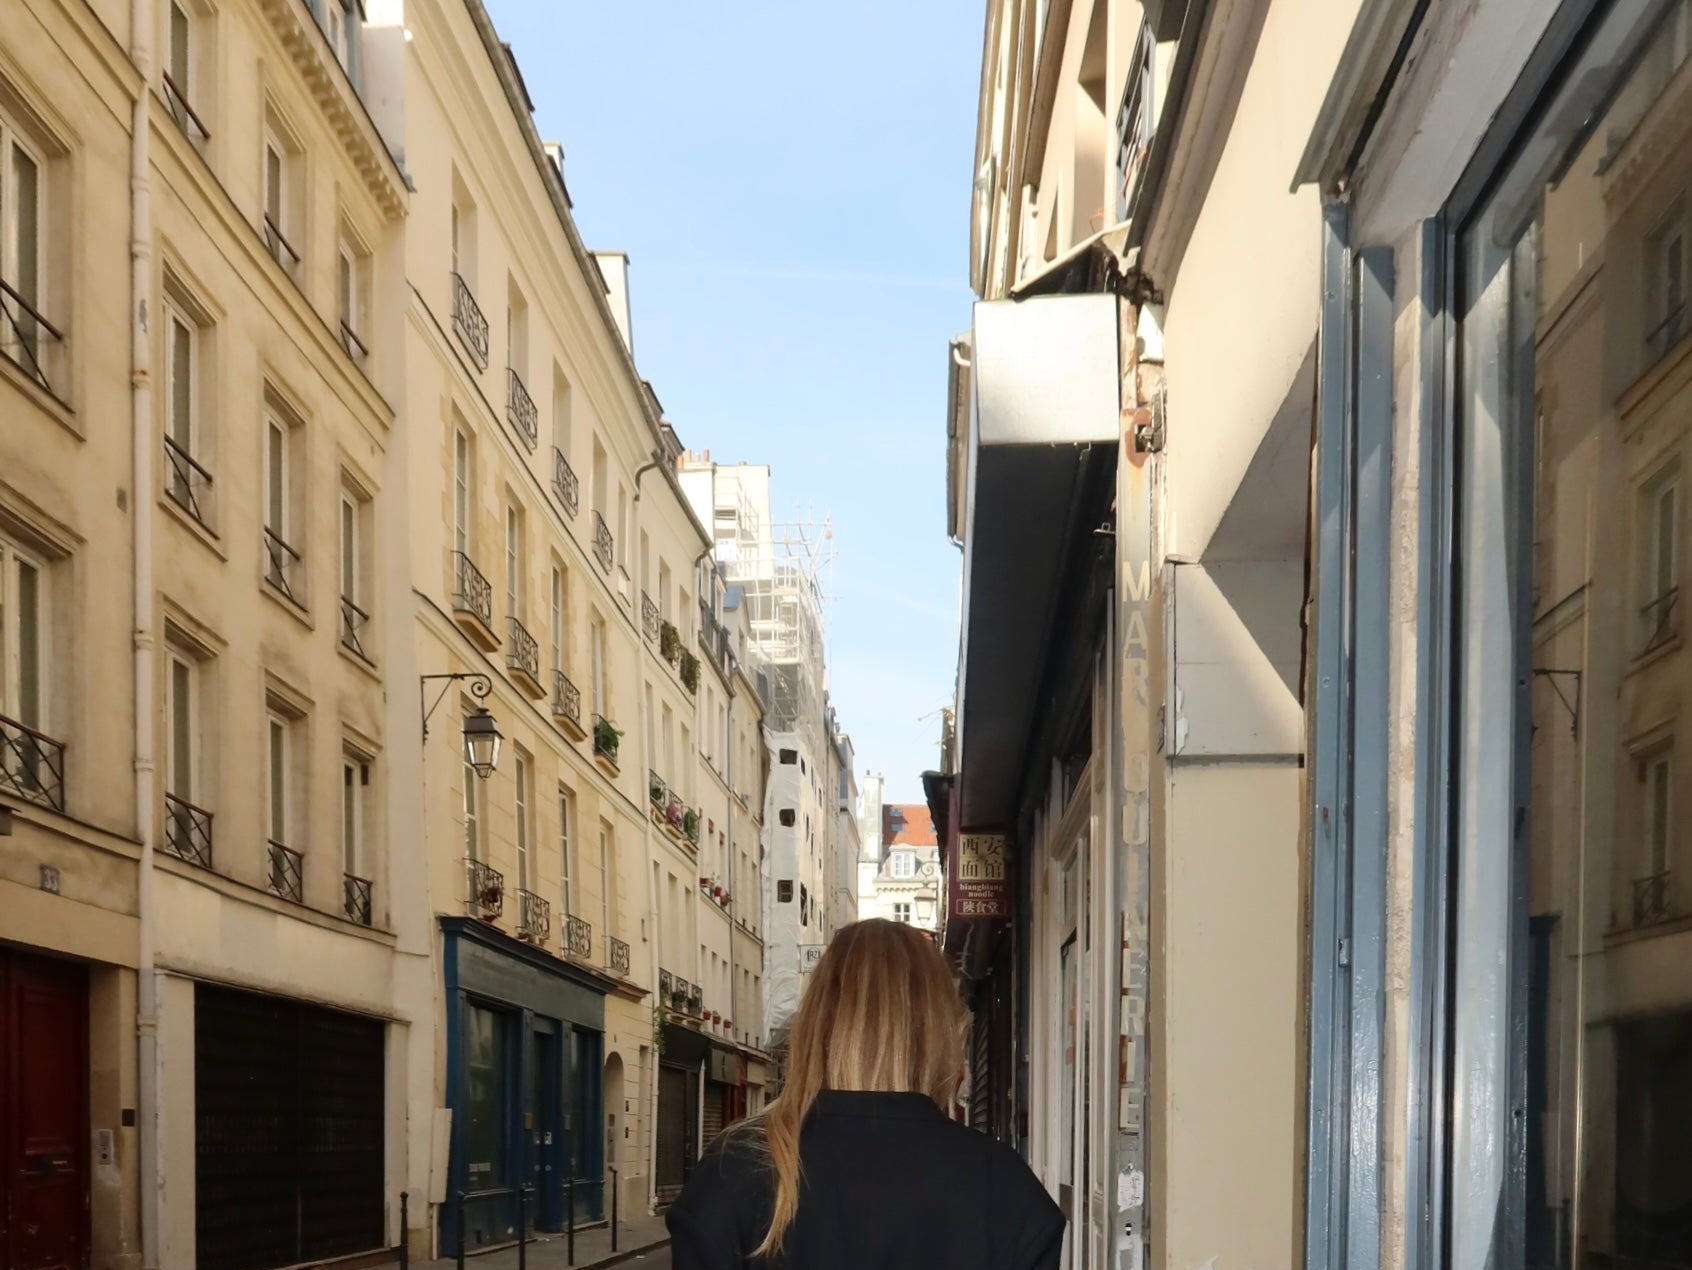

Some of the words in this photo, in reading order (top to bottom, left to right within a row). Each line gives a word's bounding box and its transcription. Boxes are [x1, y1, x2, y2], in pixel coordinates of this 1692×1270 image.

[962, 836, 1003, 855] 西安
[1119, 560, 1149, 1129] MARQUINERIE
[962, 860, 1002, 878] 面馆
[959, 883, 1004, 892] biangbiang
